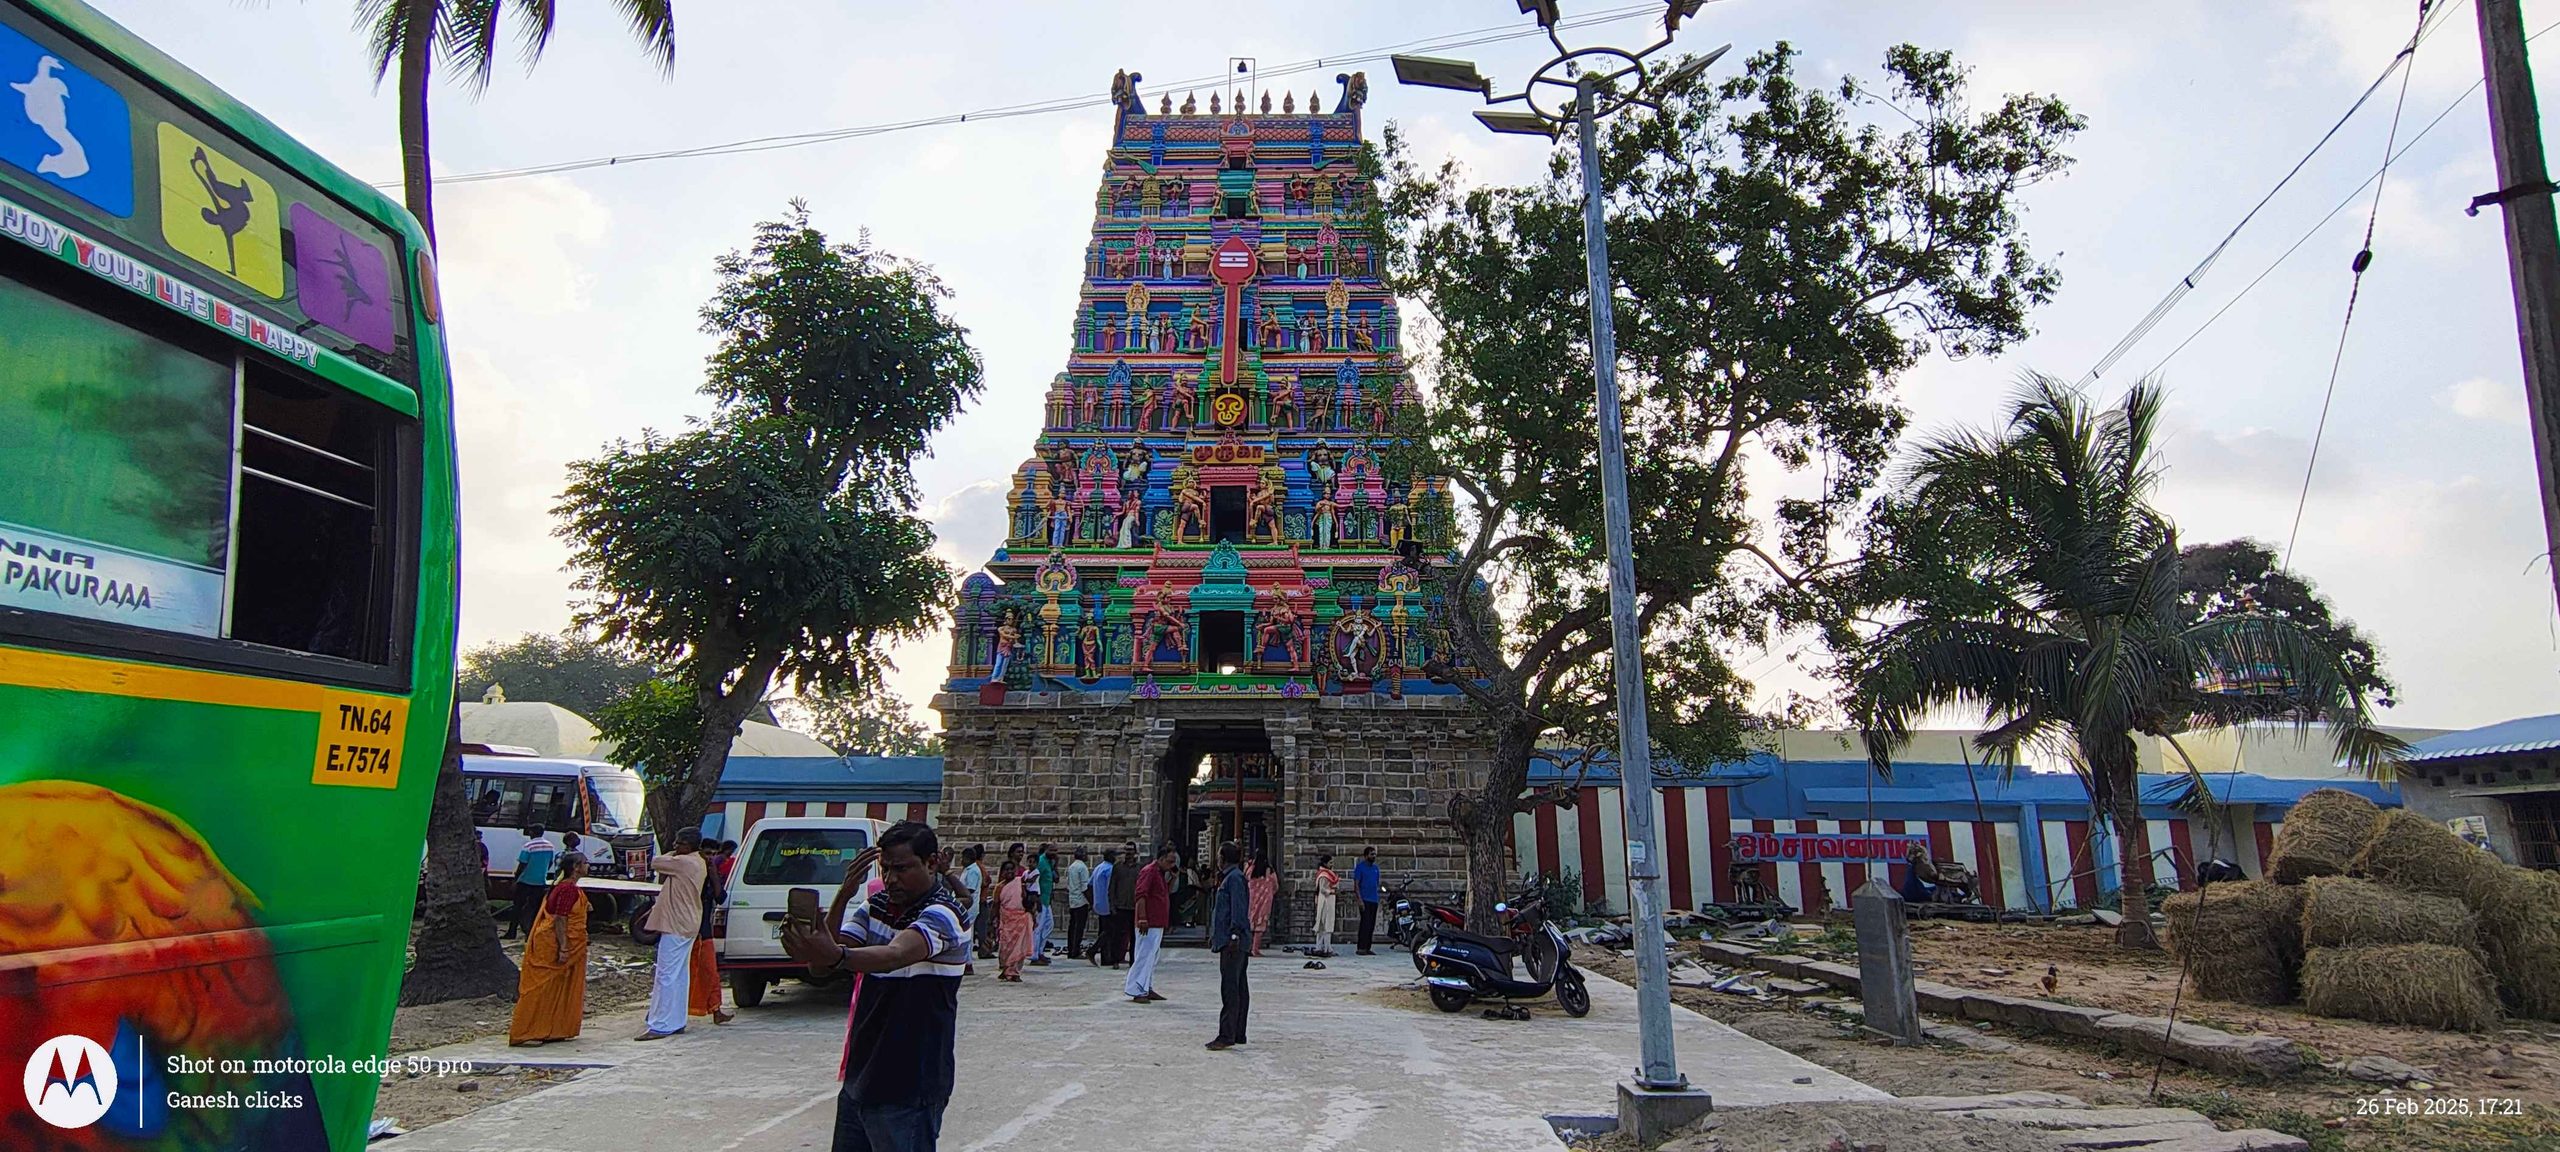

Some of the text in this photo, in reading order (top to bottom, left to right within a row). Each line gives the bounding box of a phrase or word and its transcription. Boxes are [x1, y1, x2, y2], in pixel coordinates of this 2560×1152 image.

[72, 233, 151, 294] YOUR
[154, 272, 209, 320] LIFE
[213, 299, 246, 336] BE
[247, 315, 320, 368] HAPPY
[1193, 445, 1265, 462] முருகா
[5, 560, 151, 612] PAKURAAA
[339, 704, 392, 735] TN.64
[326, 744, 391, 774] E.7574
